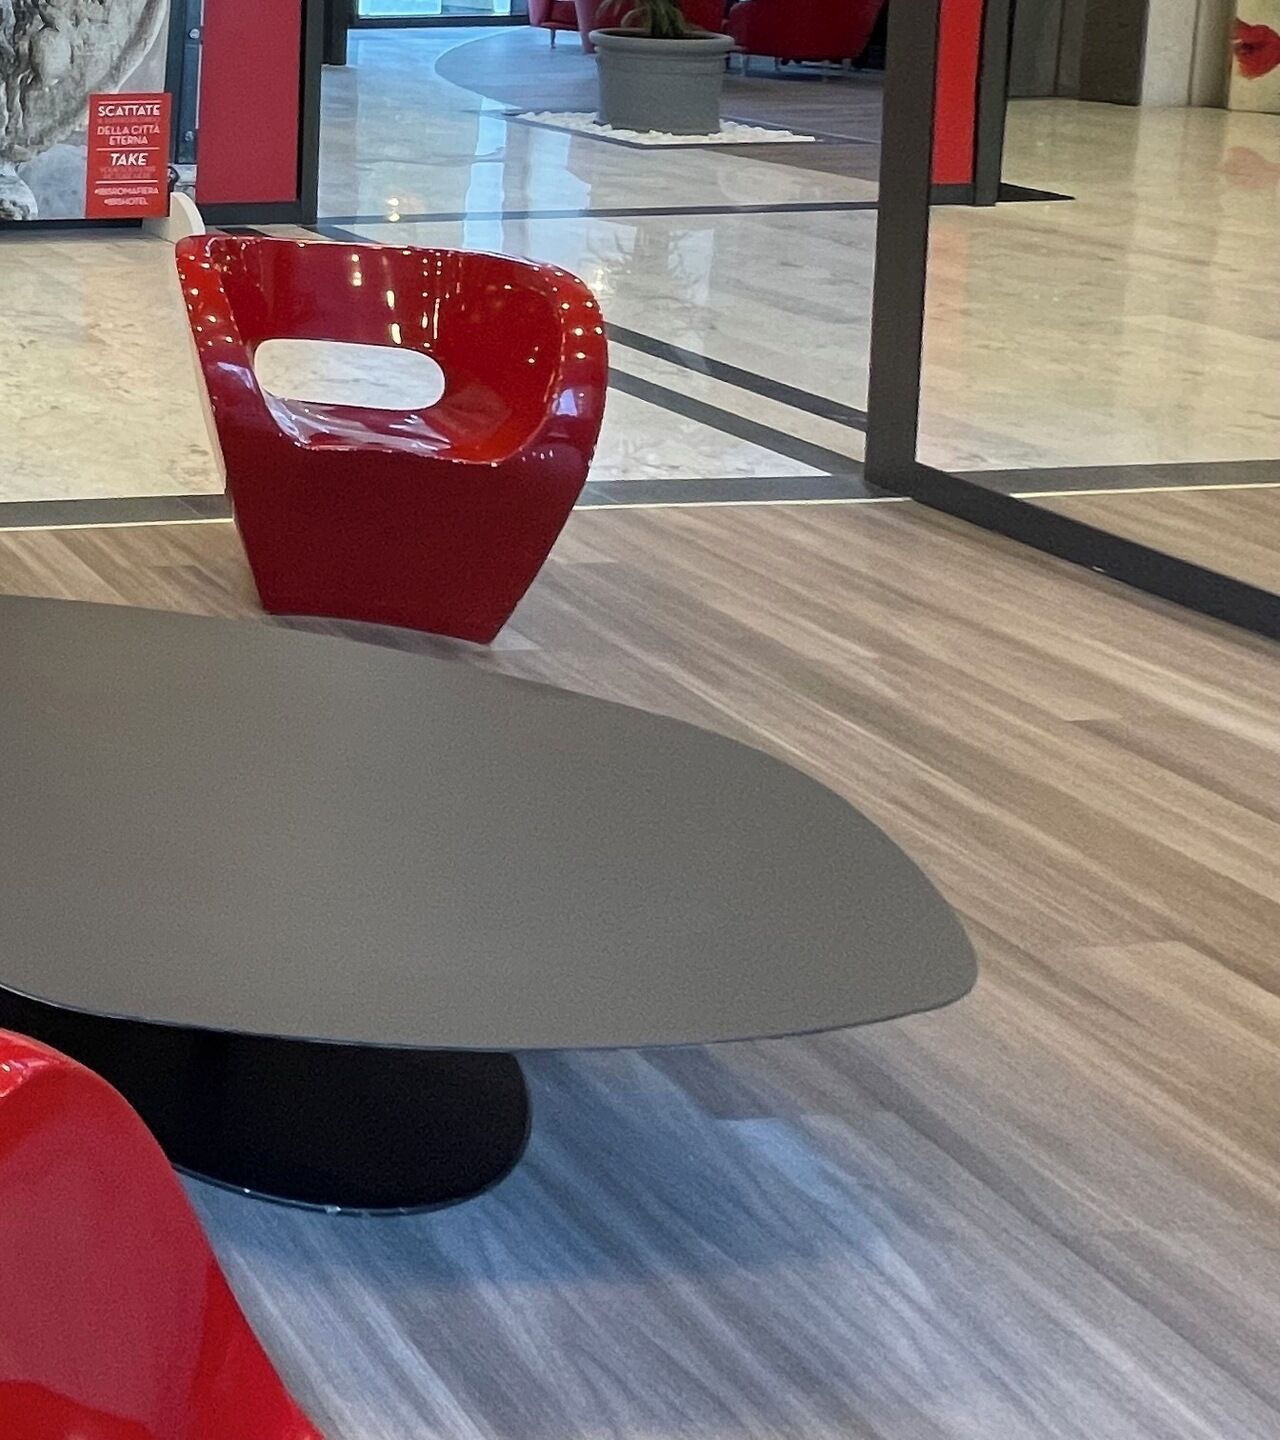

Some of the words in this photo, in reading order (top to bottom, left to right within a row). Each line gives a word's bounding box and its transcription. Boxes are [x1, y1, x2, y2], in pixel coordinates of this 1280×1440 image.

[97, 104, 161, 117] SCATTATE
[96, 125, 130, 136] DELLA
[108, 135, 149, 146] ETERNA
[110, 152, 149, 166] TAKE
